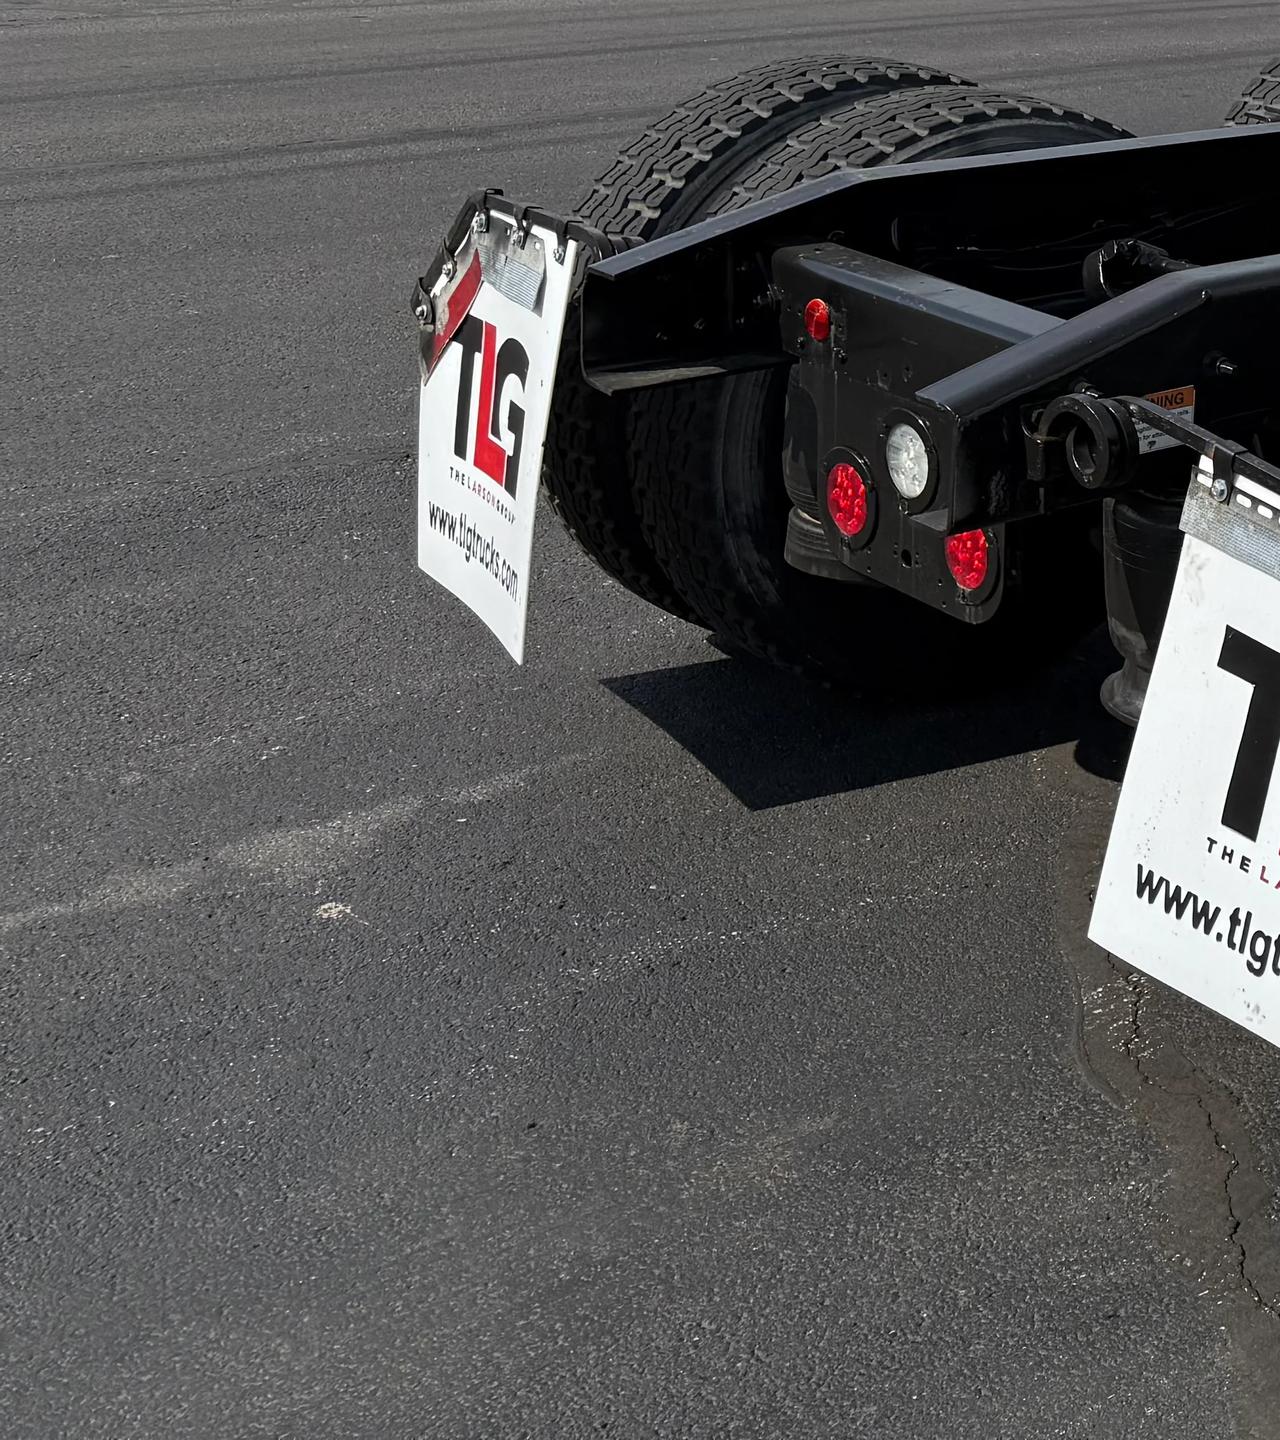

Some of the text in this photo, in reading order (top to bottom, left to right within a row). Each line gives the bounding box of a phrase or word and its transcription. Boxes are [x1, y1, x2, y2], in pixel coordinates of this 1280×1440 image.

[453, 312, 531, 501] TLG
[449, 466, 466, 486] THE
[466, 476, 496, 508] LARSON
[427, 499, 519, 602] www.tlgtrucks.com
[1206, 836, 1252, 873] THE
